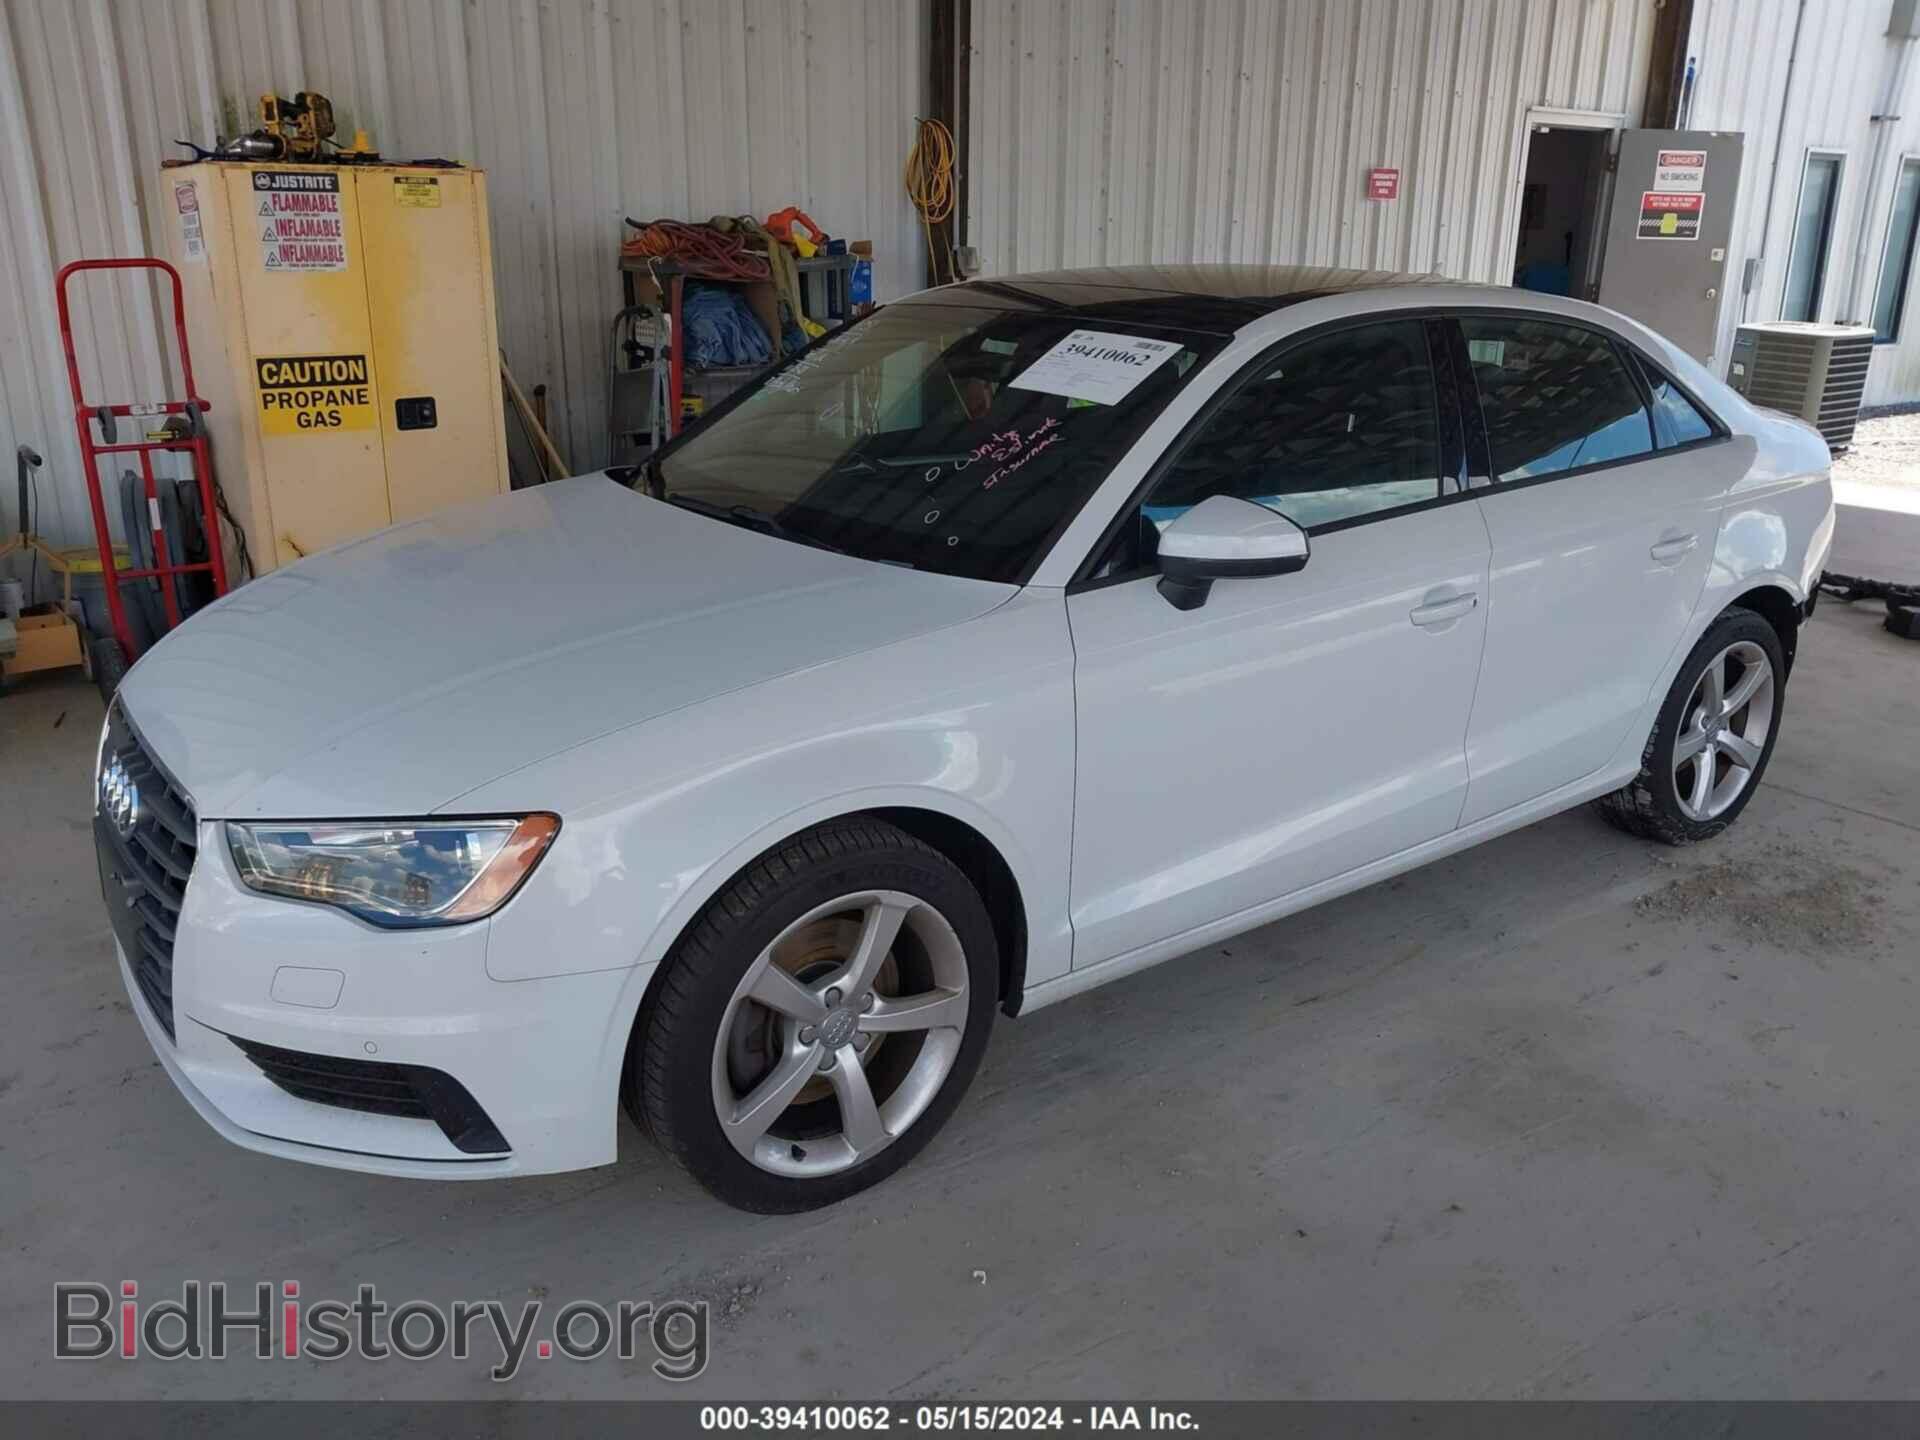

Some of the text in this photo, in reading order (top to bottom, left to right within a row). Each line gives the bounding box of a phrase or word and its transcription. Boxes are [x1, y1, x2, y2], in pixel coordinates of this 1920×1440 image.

[271, 174, 332, 189] JUSTRITE
[271, 193, 338, 212] FLAMMABLE
[275, 218, 341, 237] INFLAMABLE
[279, 244, 345, 262] INFLAMMABLE
[1059, 343, 1151, 366] 39410062
[261, 360, 365, 384] CAUTION
[262, 388, 369, 410] PROPANE
[296, 409, 342, 428] GAS
